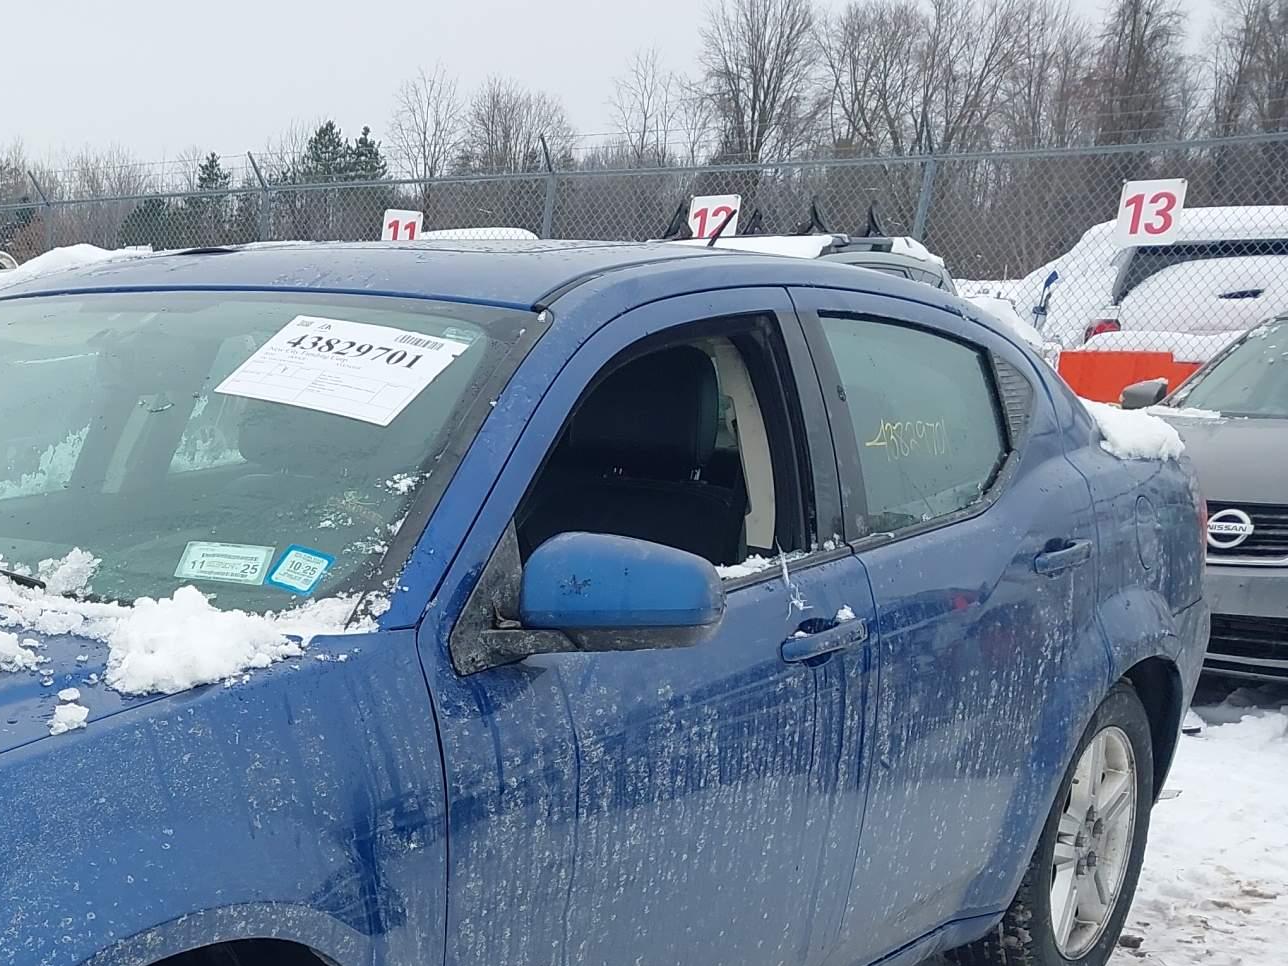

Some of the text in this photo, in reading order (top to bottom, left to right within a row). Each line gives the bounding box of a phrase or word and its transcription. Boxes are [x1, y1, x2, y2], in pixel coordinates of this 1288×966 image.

[694, 206, 734, 239] 12
[1125, 192, 1176, 235] 13
[388, 219, 416, 240] 11
[287, 334, 423, 369] 43829701
[1207, 524, 1247, 532] NISSAN
[240, 564, 258, 574] 25
